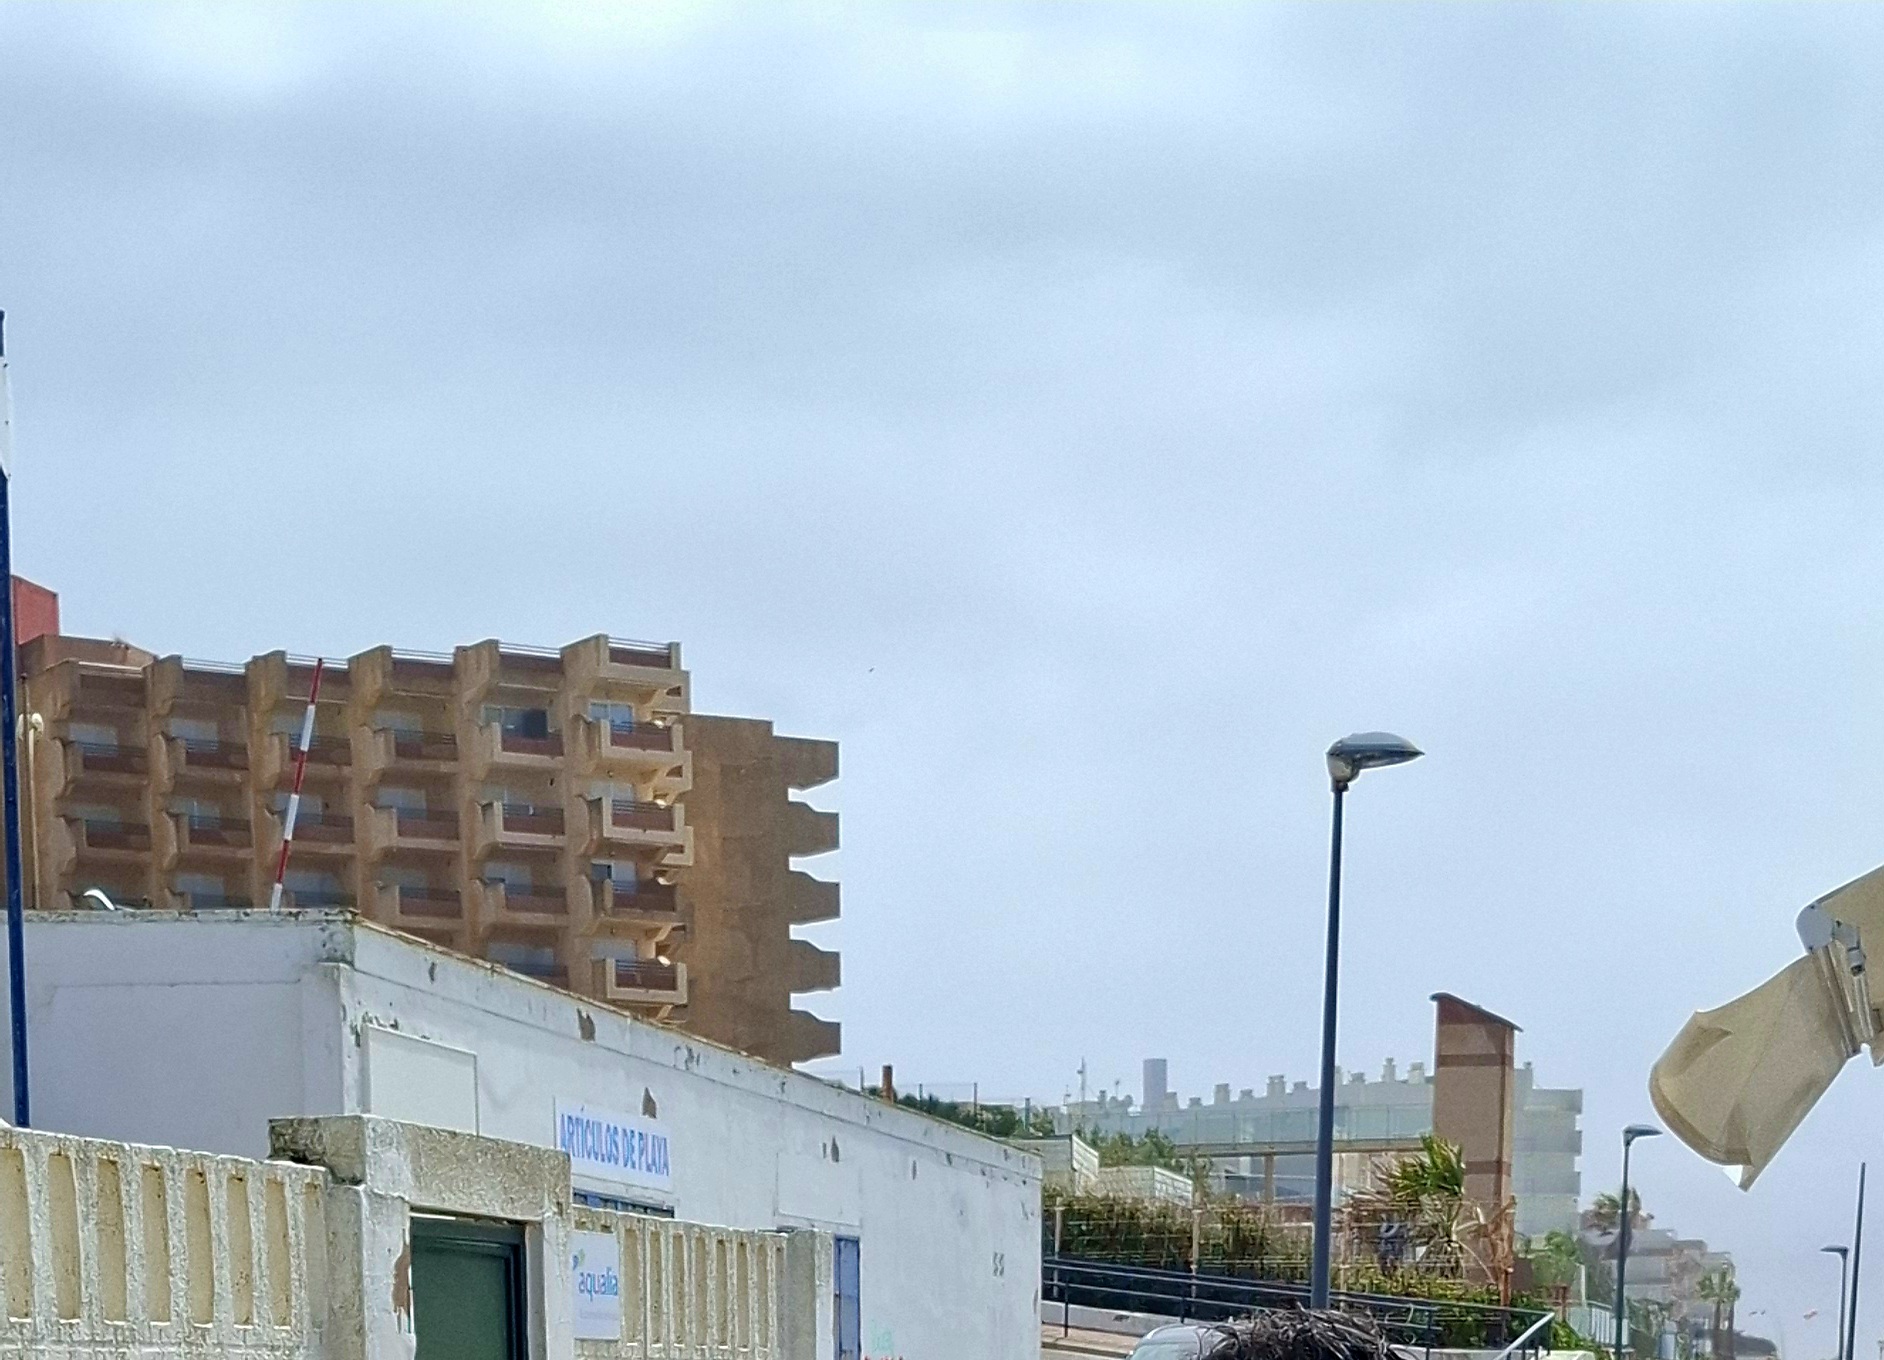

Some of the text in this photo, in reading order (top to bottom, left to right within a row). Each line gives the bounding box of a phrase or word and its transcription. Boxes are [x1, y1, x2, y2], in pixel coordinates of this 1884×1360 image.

[622, 1127, 637, 1170] DE
[637, 1131, 670, 1177] PLAYA
[579, 1266, 618, 1302] aqualia
